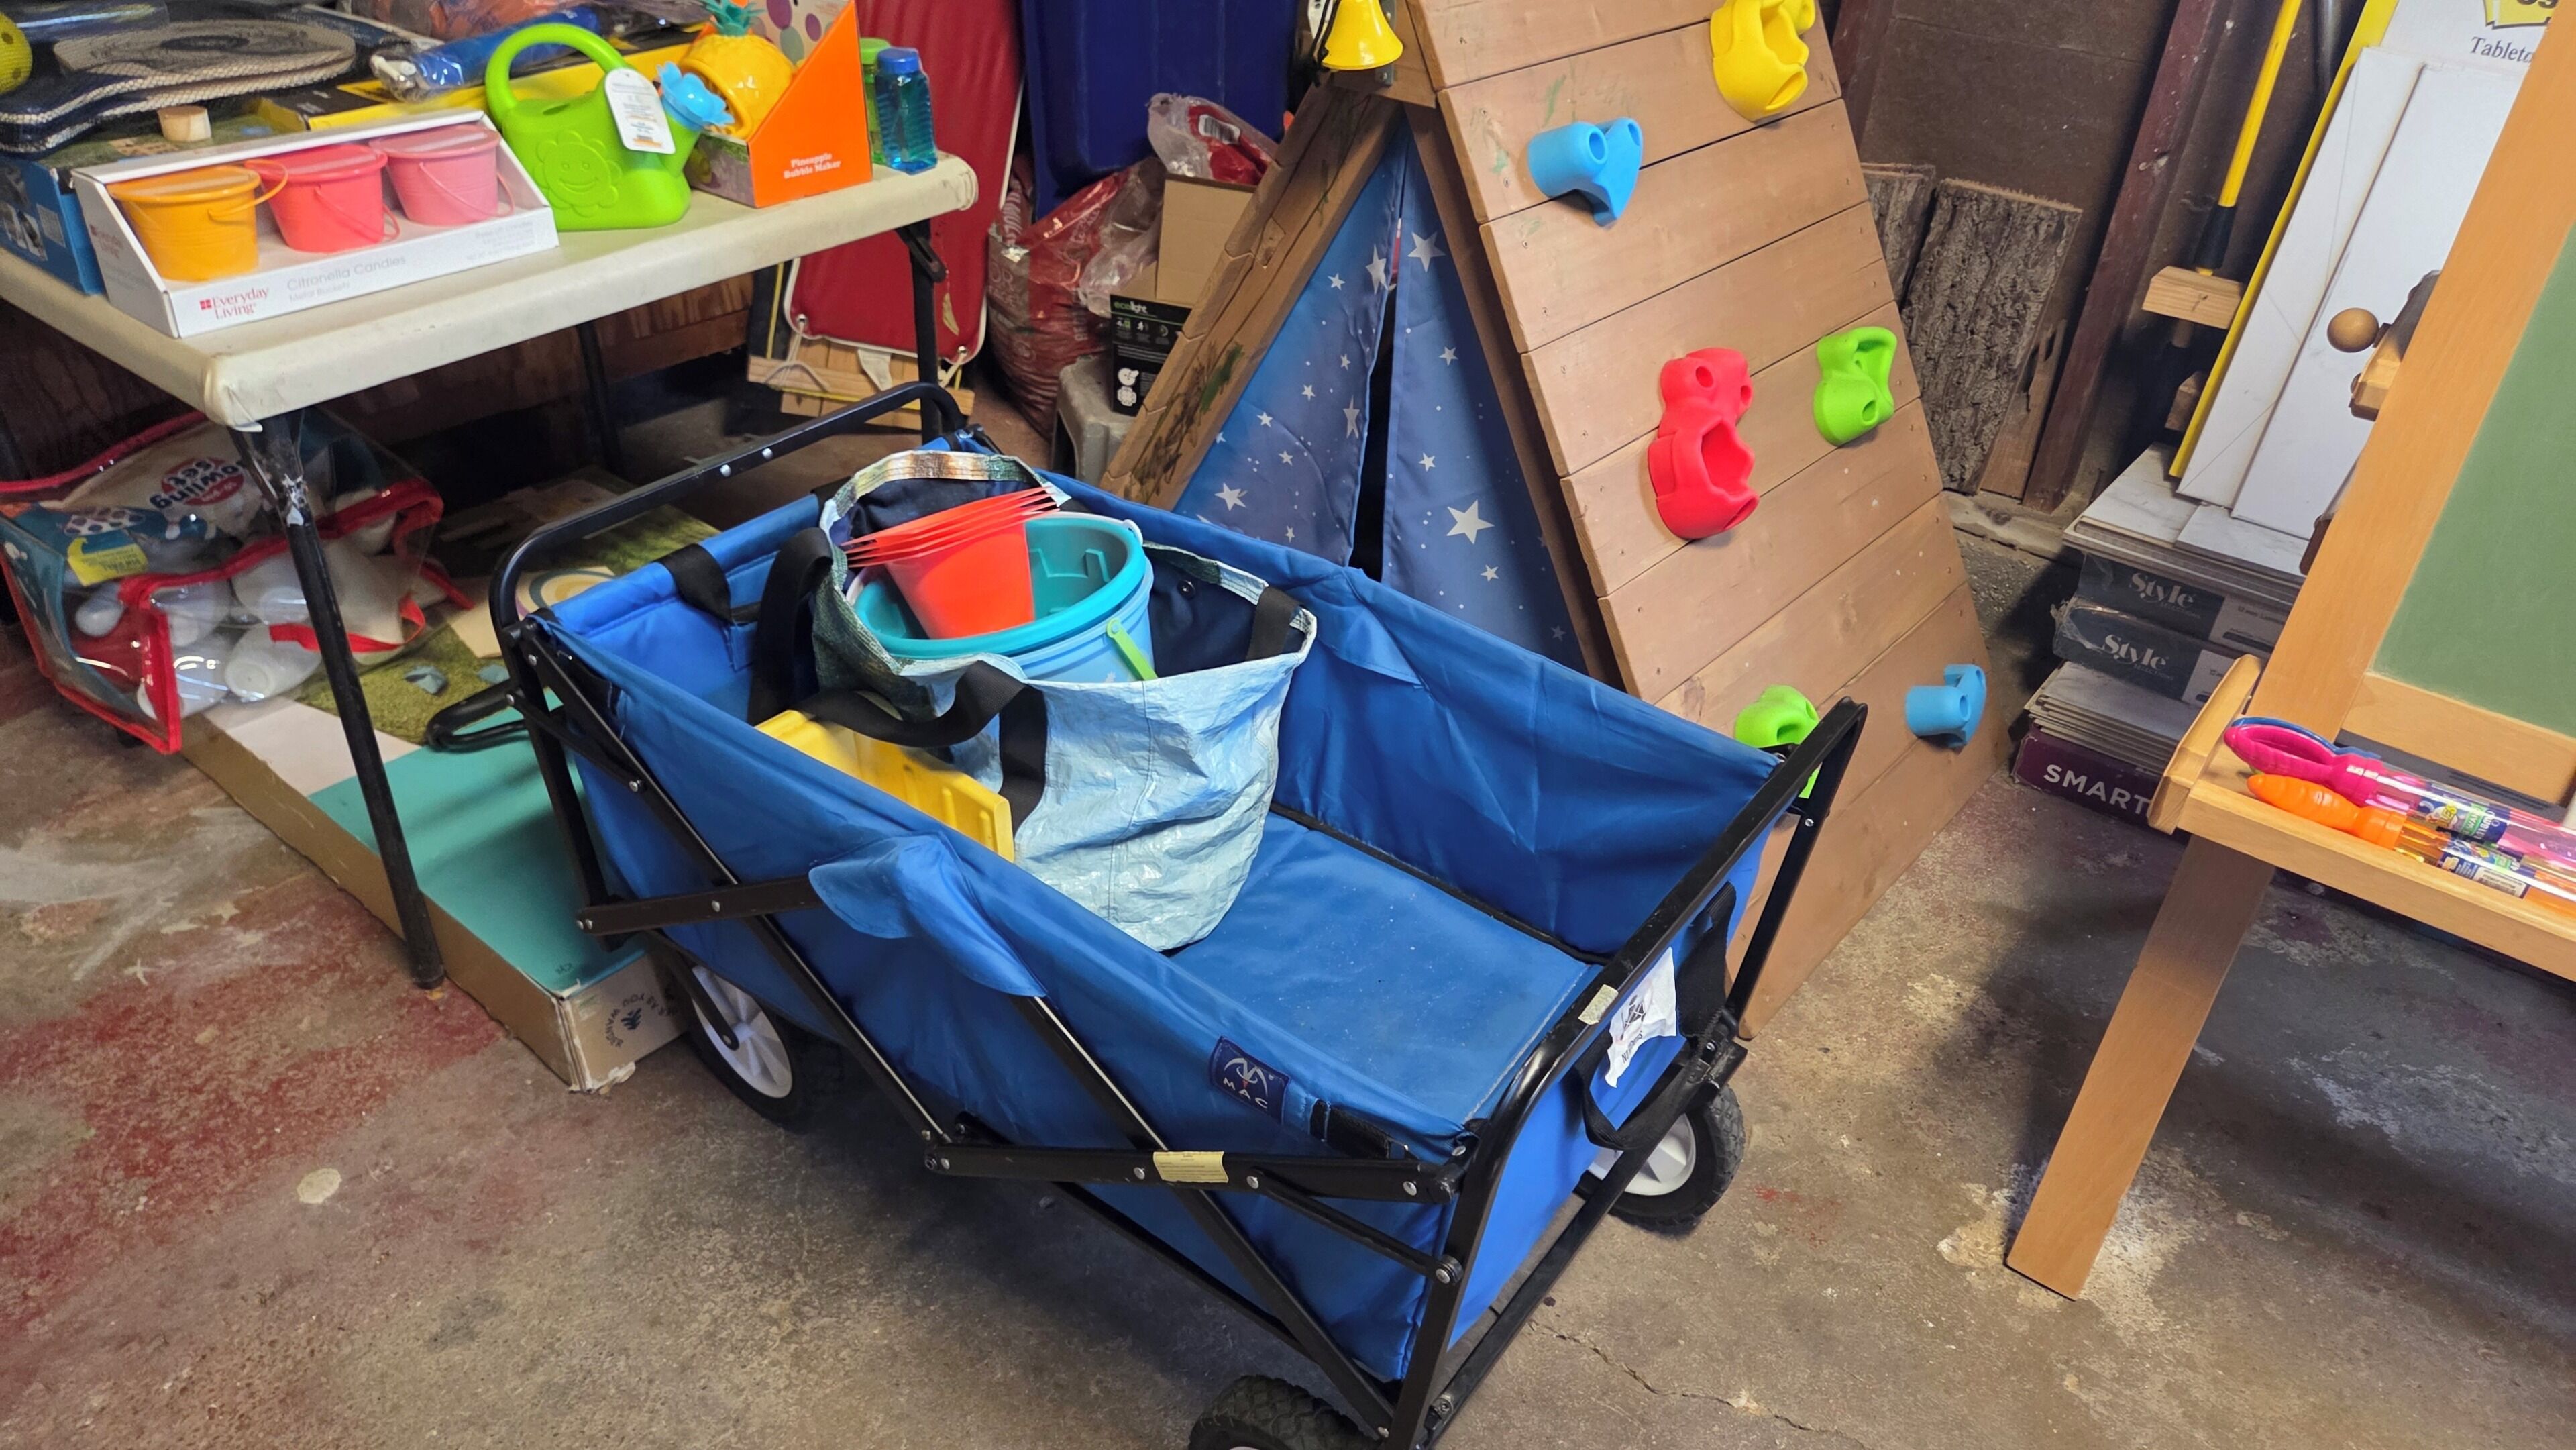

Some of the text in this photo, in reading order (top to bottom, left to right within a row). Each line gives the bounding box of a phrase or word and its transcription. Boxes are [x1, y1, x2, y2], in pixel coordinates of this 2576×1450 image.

[784, 160, 841, 179] Bubble Maker
[790, 152, 833, 168] Pineapple
[286, 256, 406, 291] Citronella Candles
[212, 287, 269, 308] Everyday
[215, 302, 254, 320] Living
[150, 460, 246, 509] owling
[2129, 572, 2194, 607] Style
[2104, 634, 2167, 670] Style
[2044, 764, 2151, 815] SMART
[1222, 1076, 1268, 1110] MAC
